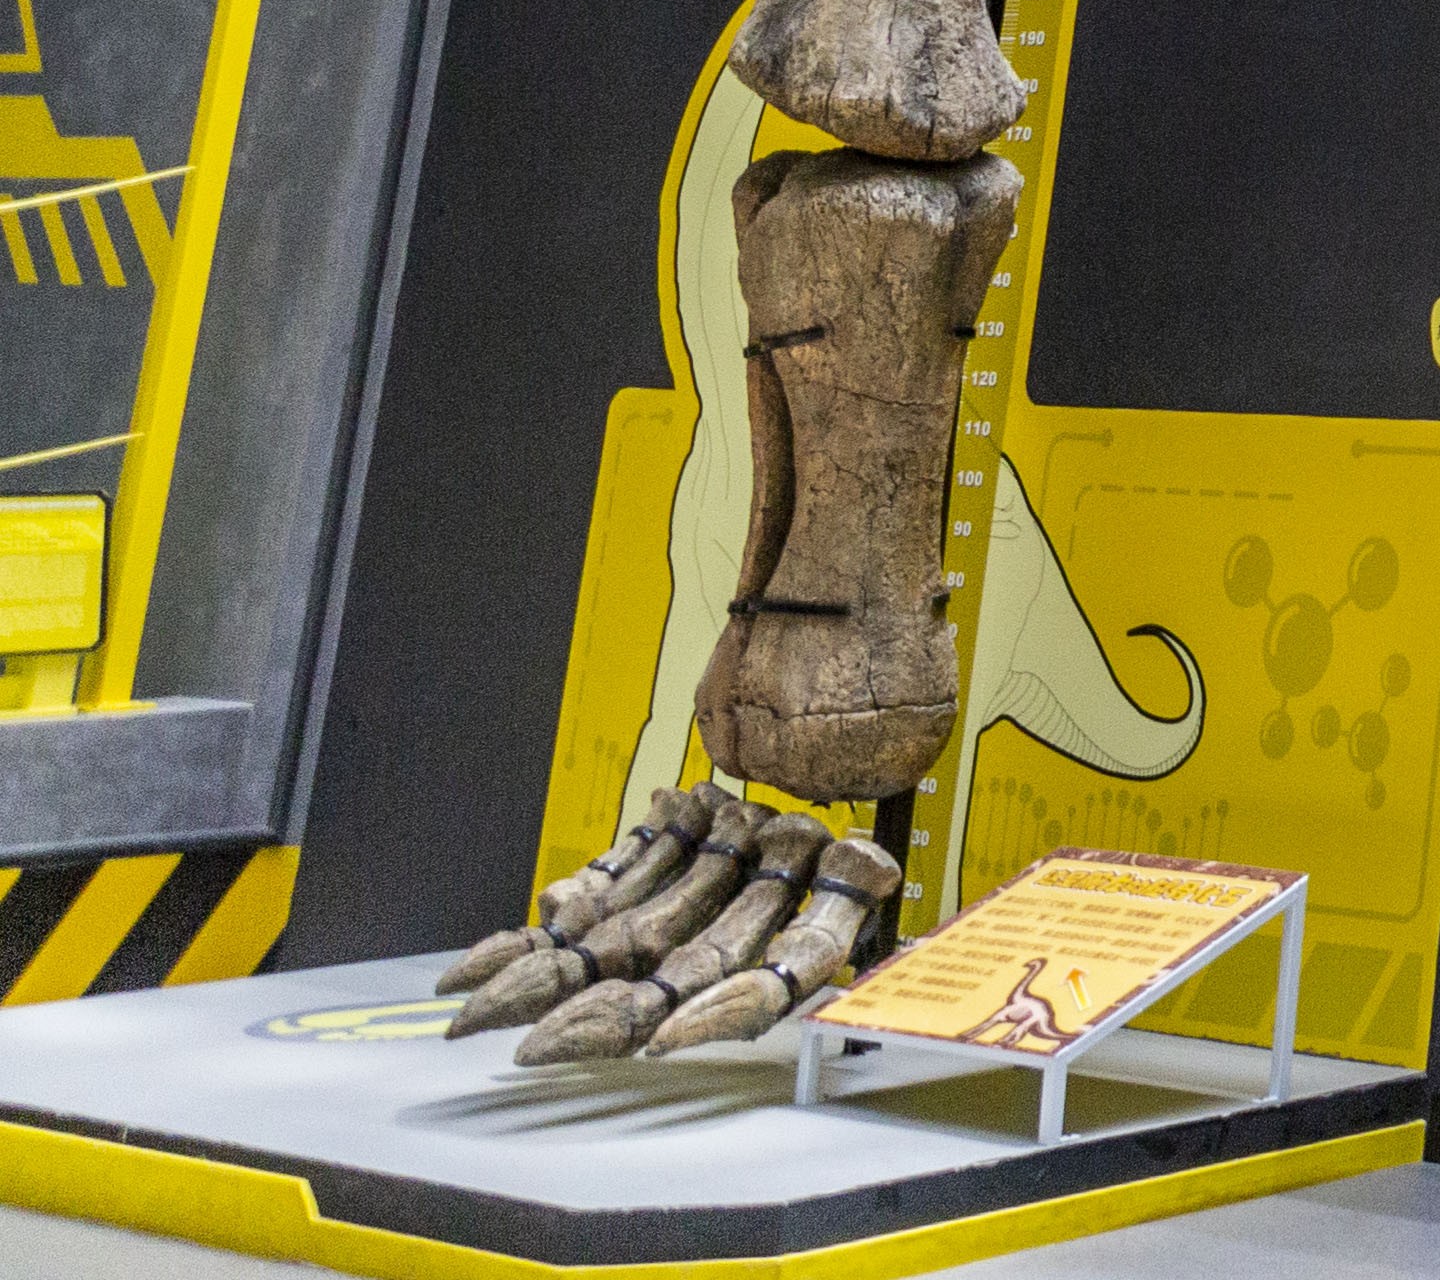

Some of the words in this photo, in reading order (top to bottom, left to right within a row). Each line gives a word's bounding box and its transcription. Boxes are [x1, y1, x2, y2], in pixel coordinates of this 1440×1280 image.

[1018, 31, 1046, 46] 190
[1006, 127, 1033, 142] 170
[977, 321, 1005, 337] 130
[971, 371, 998, 387] 120
[964, 421, 991, 436] 110
[957, 470, 984, 487] 100
[953, 520, 972, 537] 90
[946, 572, 965, 588] 80
[918, 778, 937, 794] 40
[911, 830, 930, 846] 30
[904, 883, 923, 899] 20
